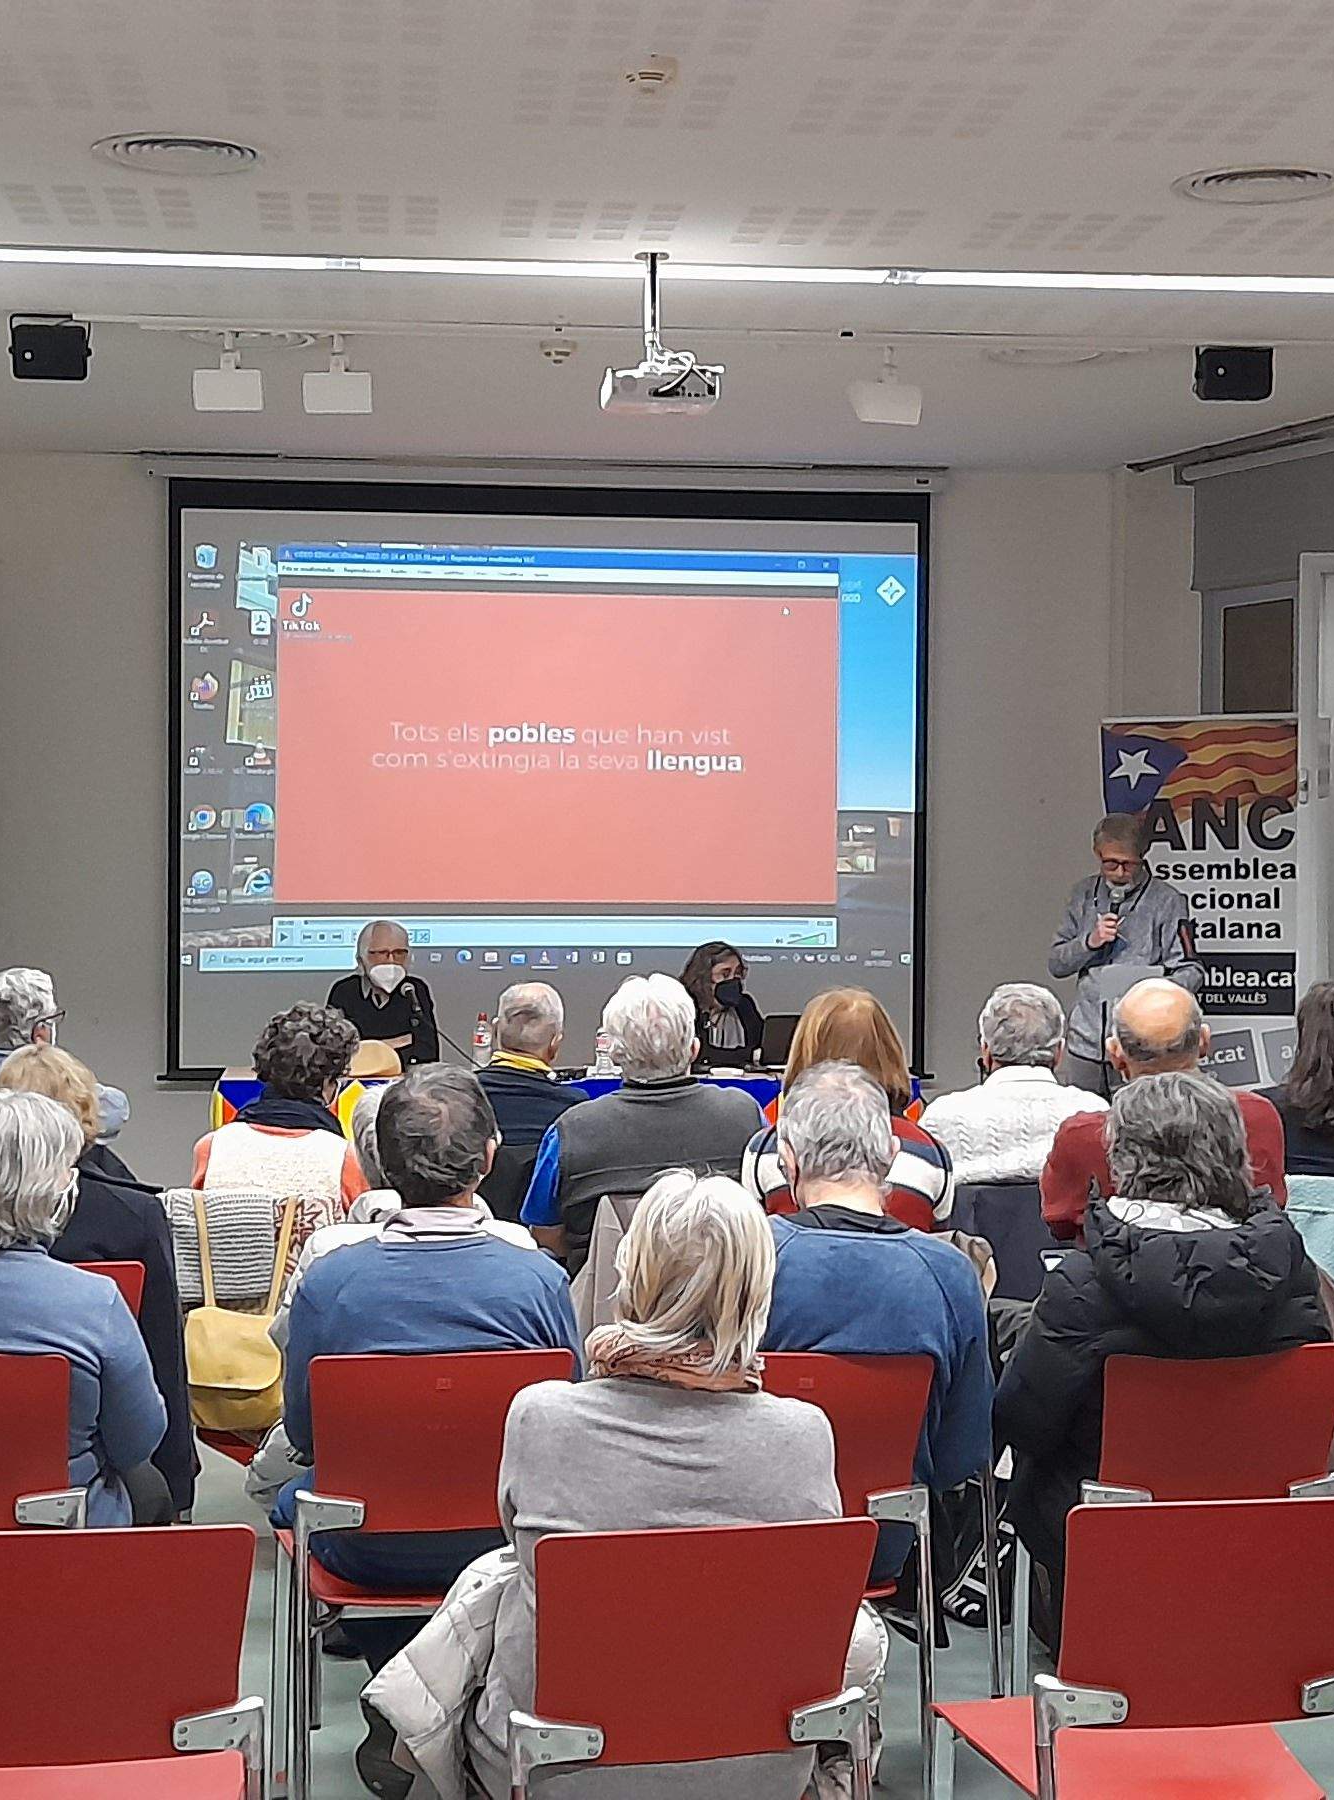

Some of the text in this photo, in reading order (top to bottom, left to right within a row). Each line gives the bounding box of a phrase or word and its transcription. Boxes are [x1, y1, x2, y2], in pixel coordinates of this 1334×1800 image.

[282, 618, 321, 631] TikTok
[390, 721, 731, 748] Tots els pobles que han vist
[371, 752, 427, 769] com
[437, 750, 550, 774] s'extingia
[559, 750, 580, 770] la
[587, 753, 639, 770] seva
[1143, 797, 1296, 851] ANC
[1155, 857, 1297, 881] ssemblea
[1186, 887, 1281, 910] cional
[1190, 917, 1282, 940] talana
[1204, 966, 1295, 988] blea.ca
[1205, 993, 1226, 1004] DEL
